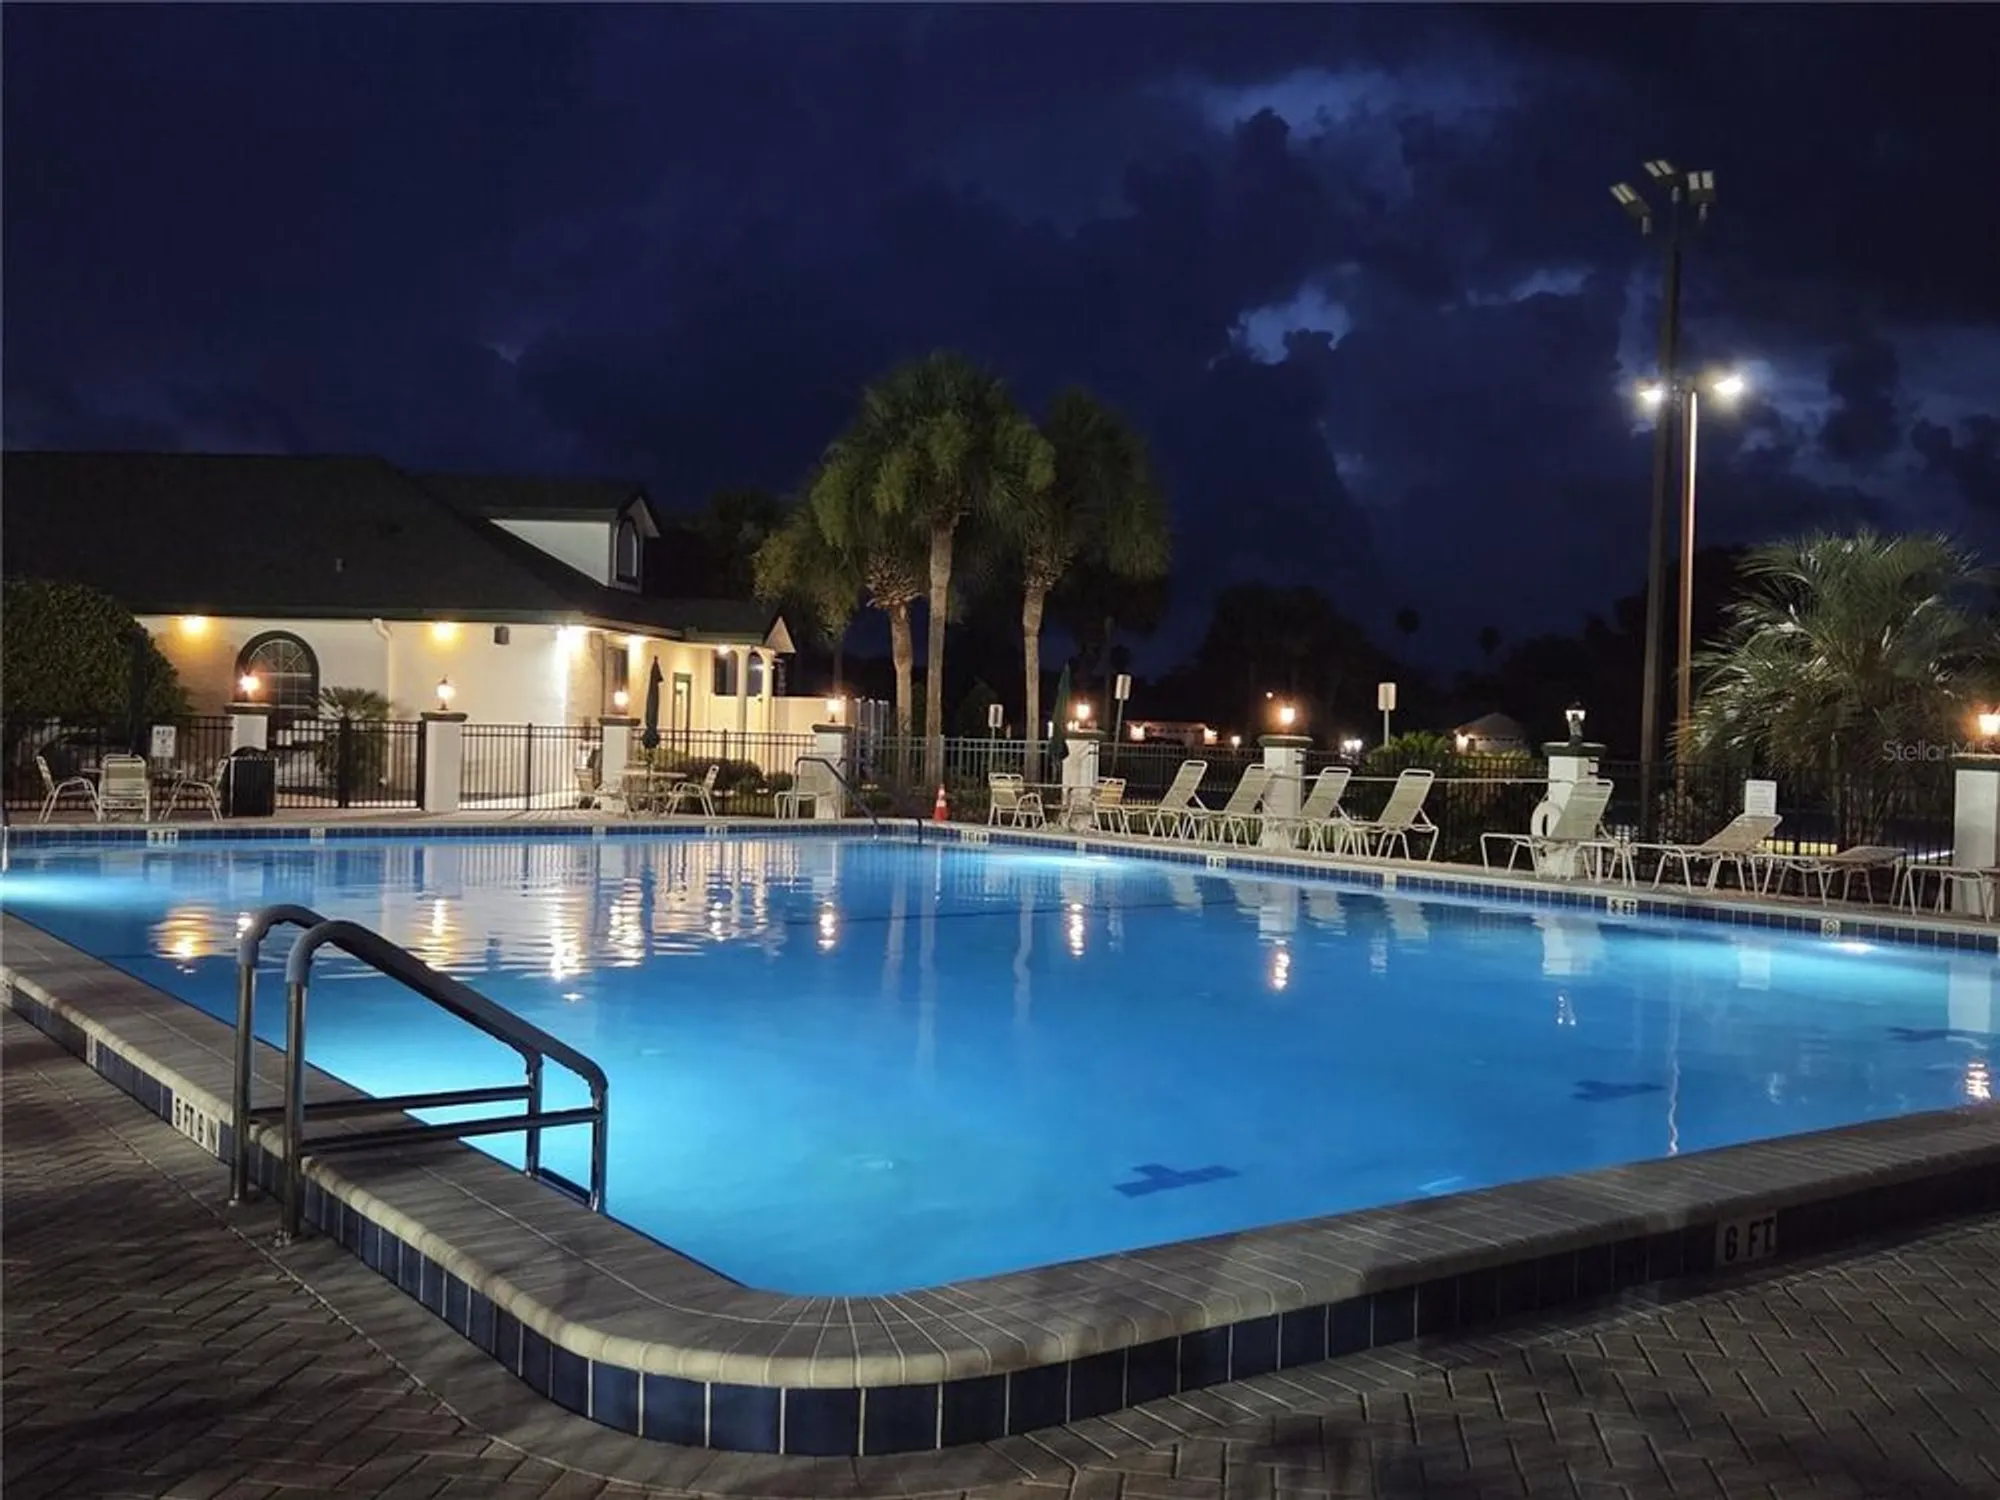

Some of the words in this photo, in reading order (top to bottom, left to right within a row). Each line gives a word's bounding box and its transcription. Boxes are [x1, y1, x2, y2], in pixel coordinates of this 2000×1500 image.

[184, 1103, 194, 1137] FT
[1725, 1225, 1738, 1262] 6
[1748, 1216, 1775, 1257] FT
